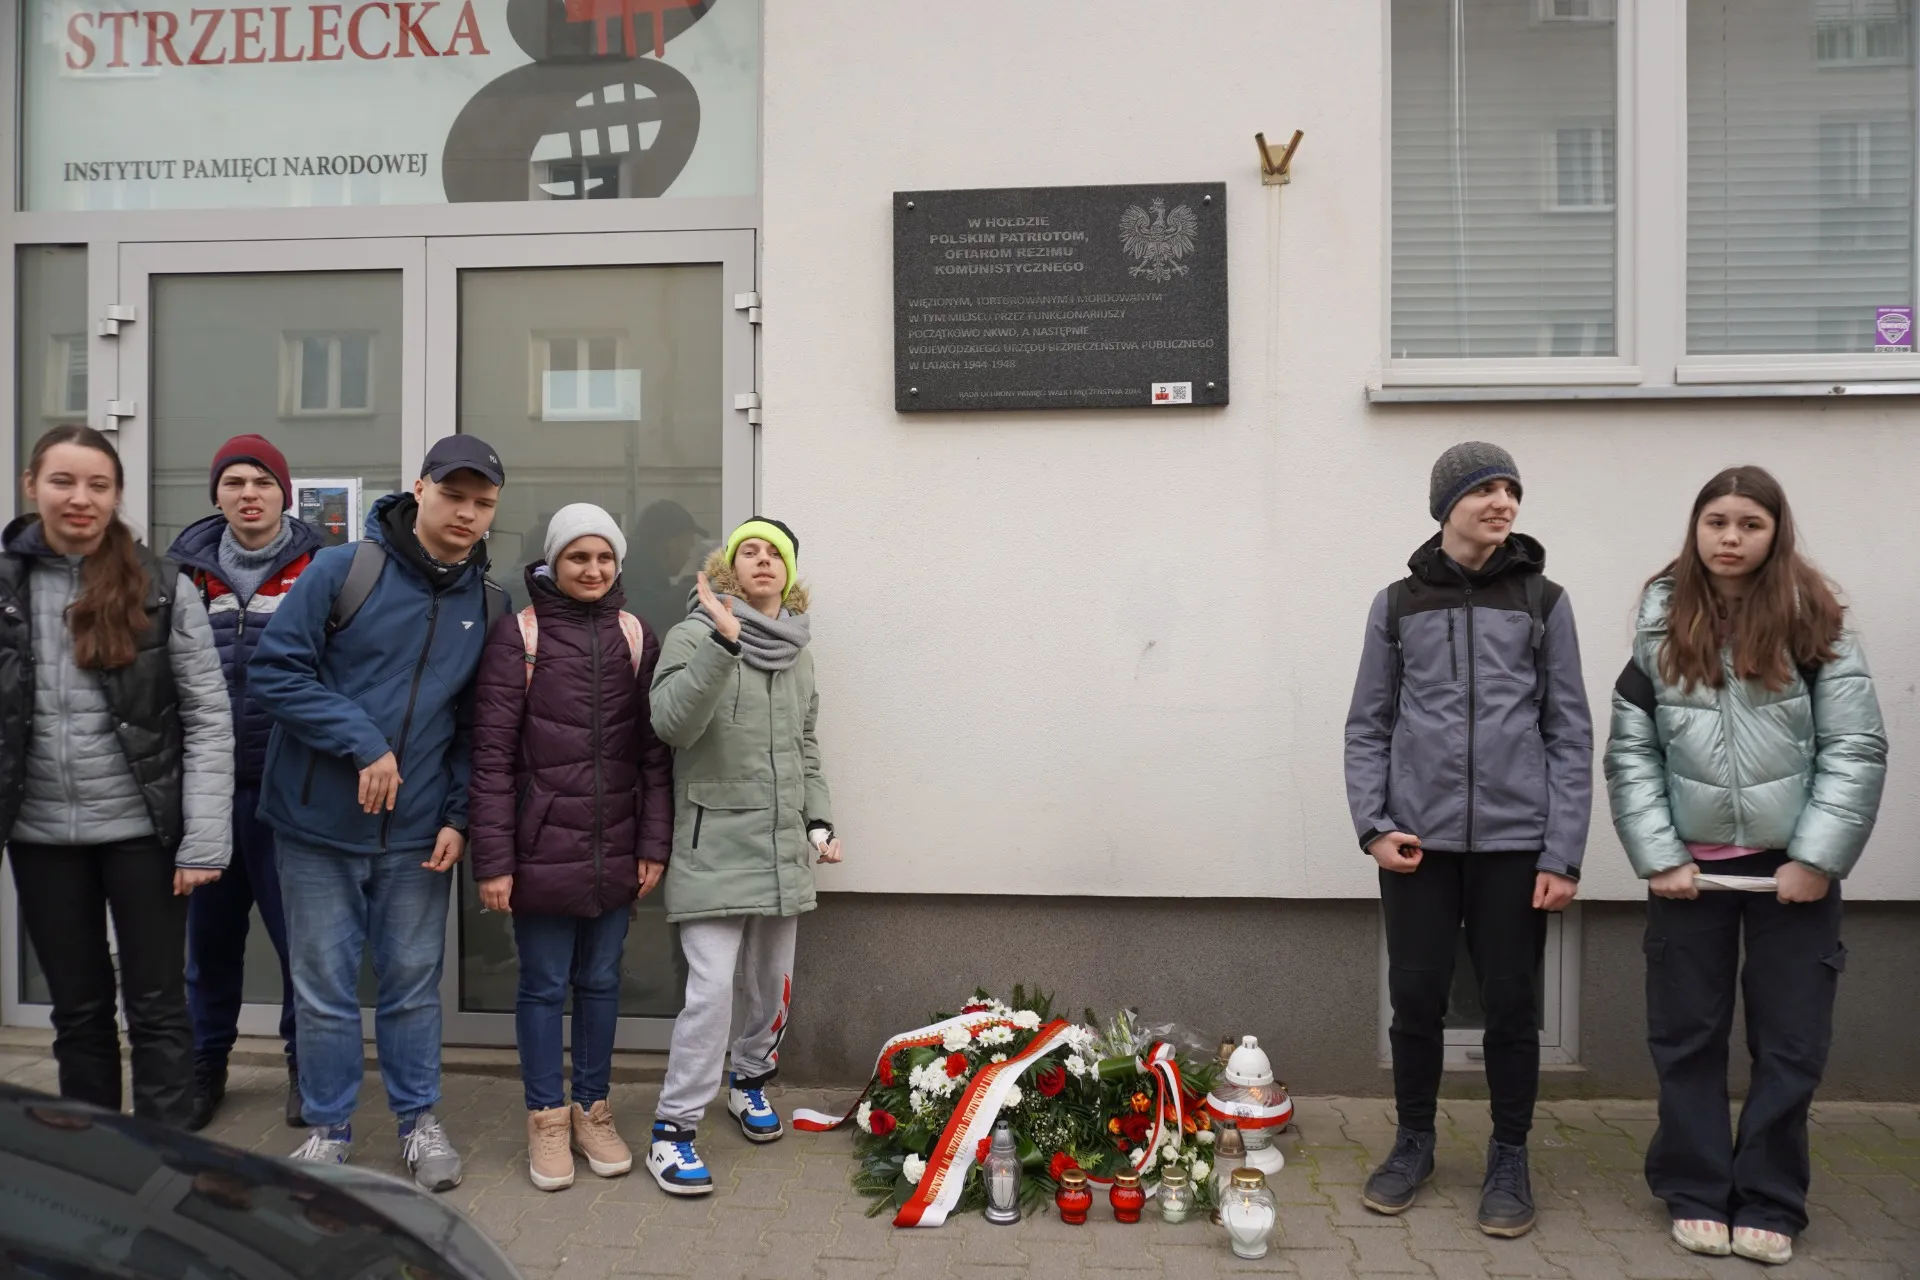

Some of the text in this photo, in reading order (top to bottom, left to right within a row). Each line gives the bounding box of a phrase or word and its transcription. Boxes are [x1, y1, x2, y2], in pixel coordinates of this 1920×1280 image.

[65, 0, 490, 70] STRZELECKA
[64, 153, 428, 183] INSTYTUT PAMIĘCI NARODOWEJ
[967, 218, 982, 228] W
[929, 231, 1089, 244] POLSKIM PATRIOTOM,
[945, 248, 1012, 260] OFIAROM
[934, 262, 1084, 275] KOMUNISTYCZNEGO
